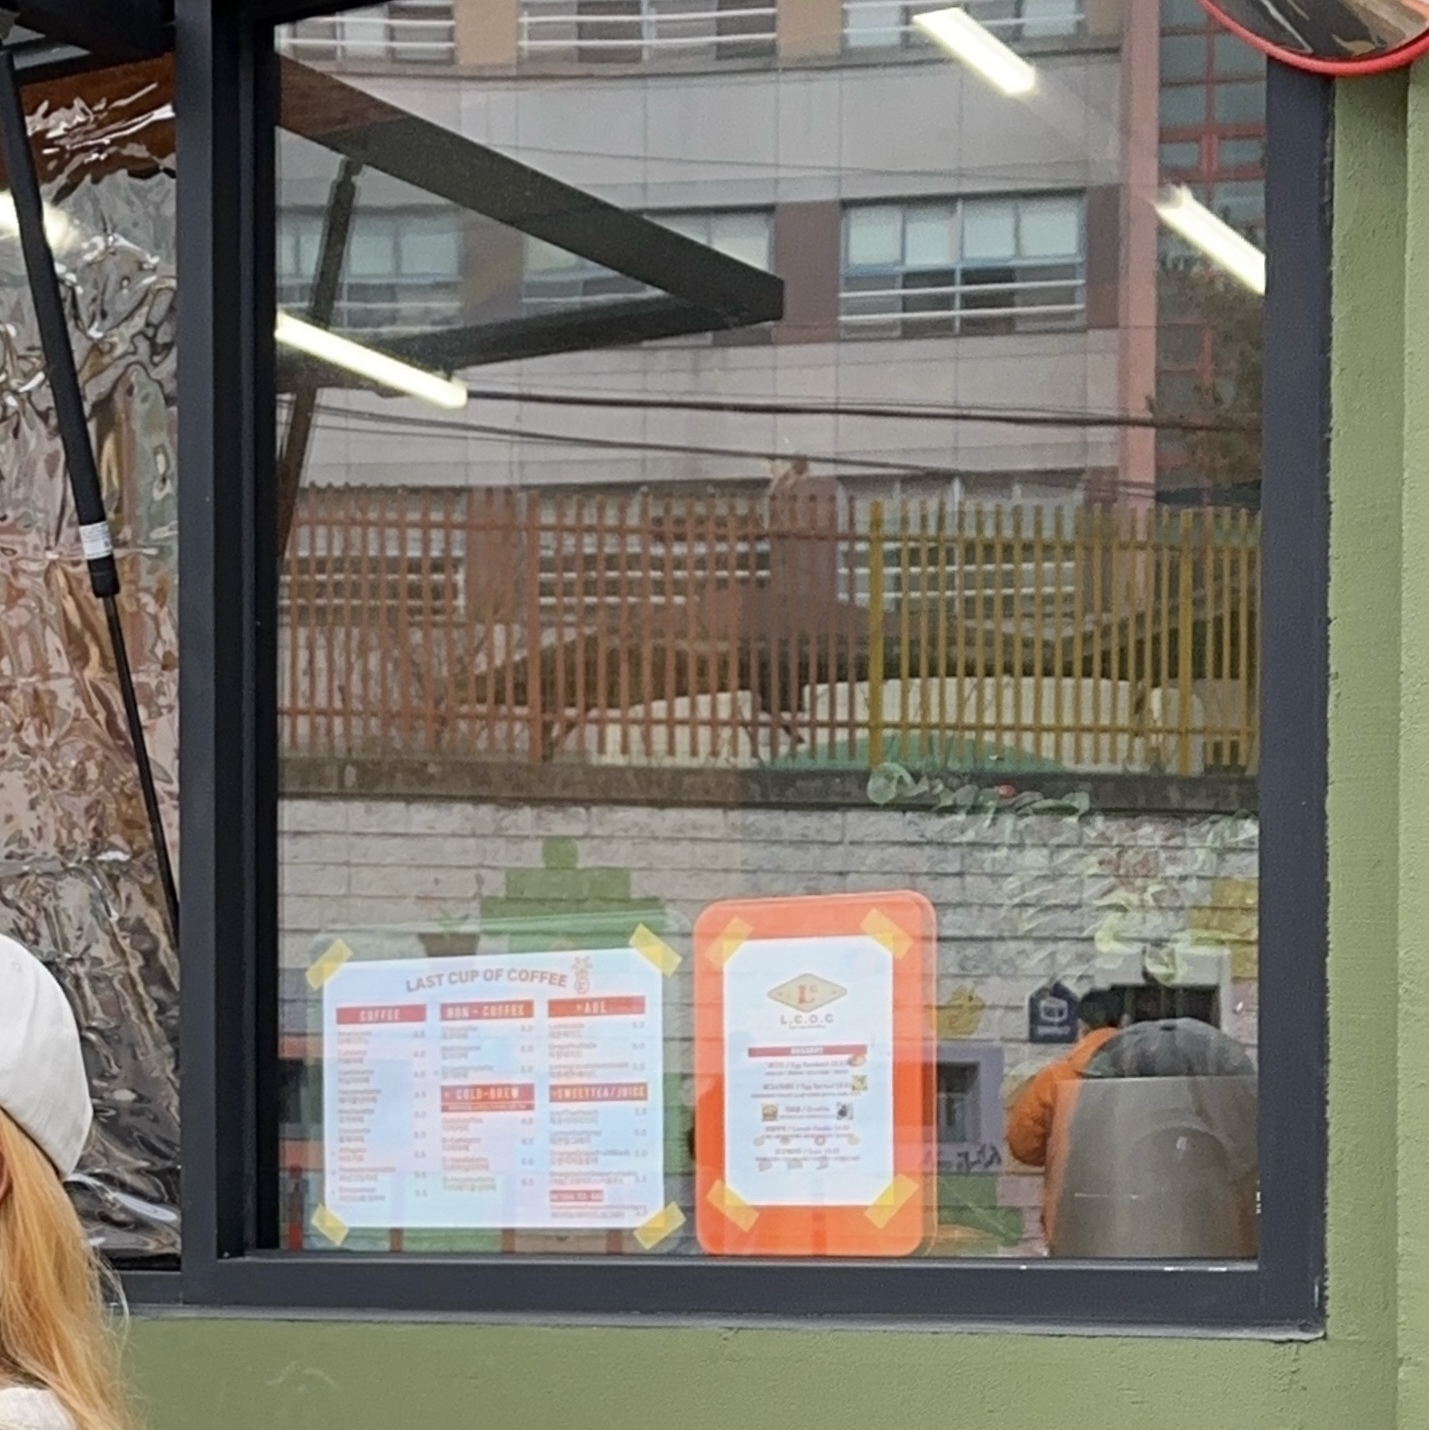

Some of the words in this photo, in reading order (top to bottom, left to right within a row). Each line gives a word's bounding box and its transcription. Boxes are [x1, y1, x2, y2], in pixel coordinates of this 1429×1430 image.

[405, 973, 445, 992] LAST
[447, 968, 480, 985] CUP
[483, 967, 505, 982] OF
[507, 968, 568, 988] COFFEE
[359, 1008, 400, 1022] COFFEE
[482, 1003, 526, 1017] COFFEE
